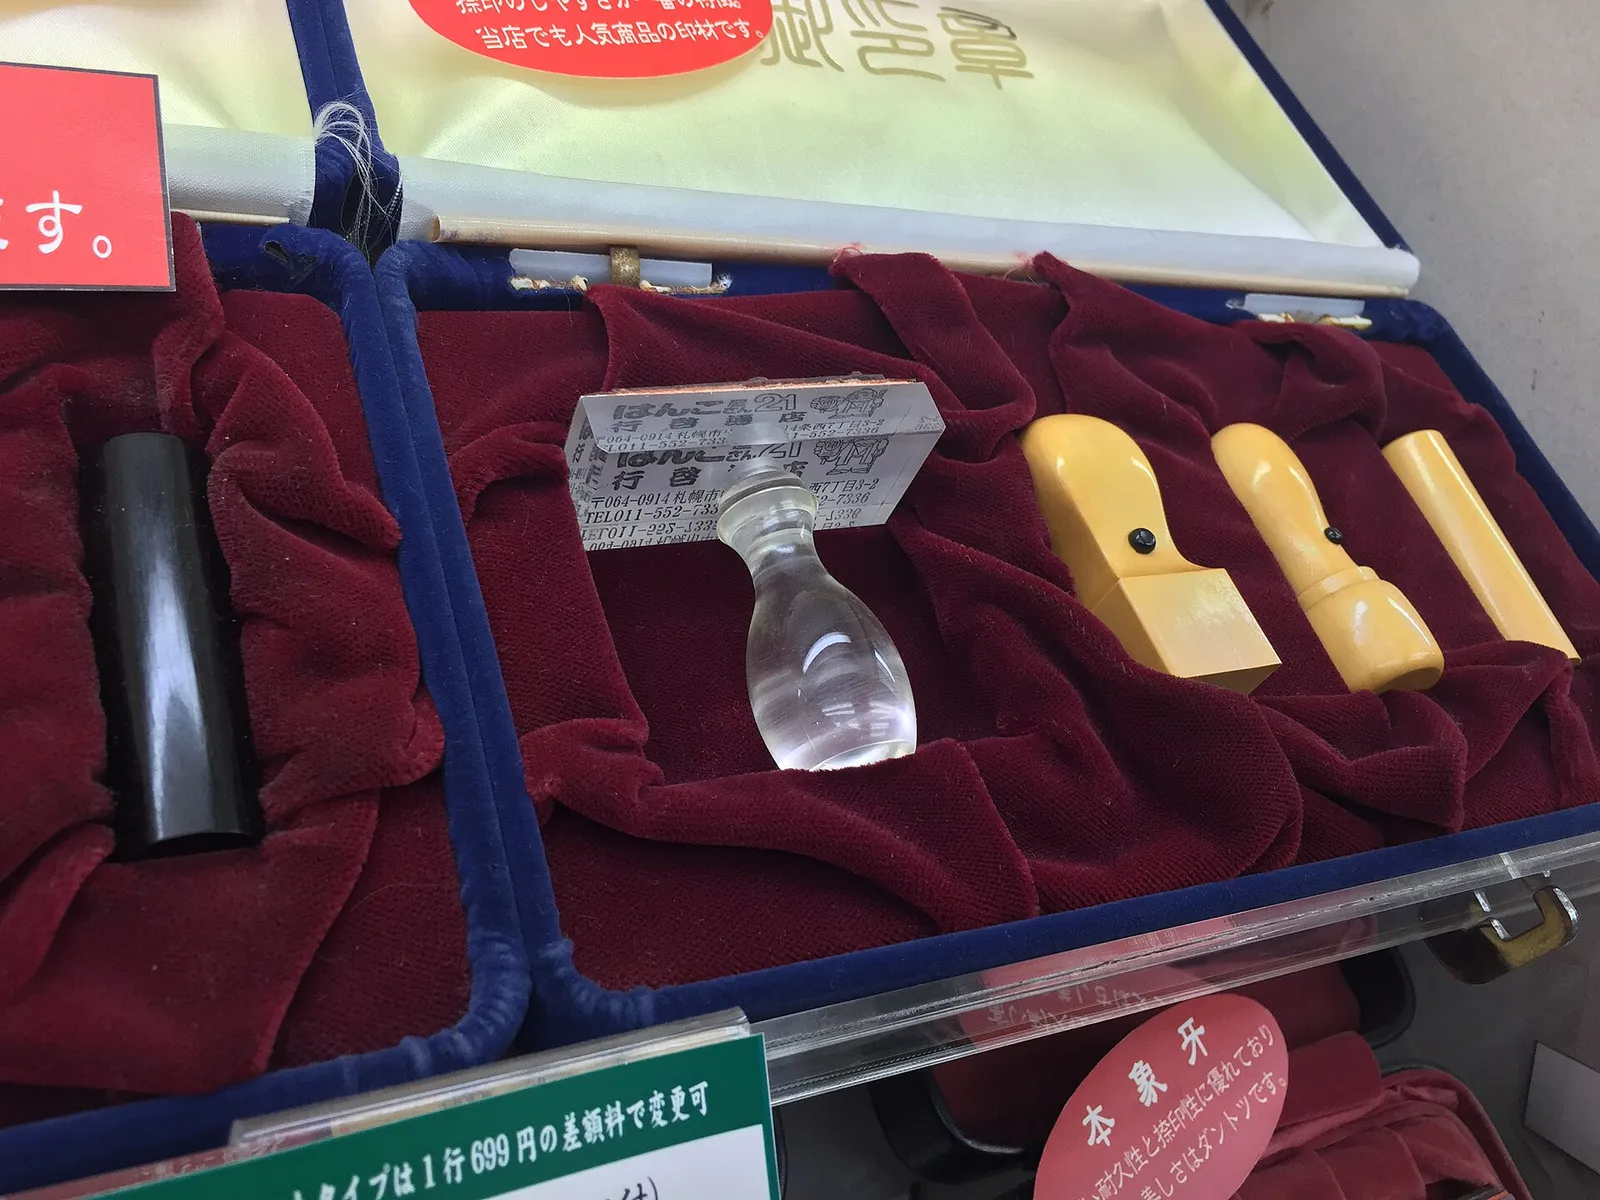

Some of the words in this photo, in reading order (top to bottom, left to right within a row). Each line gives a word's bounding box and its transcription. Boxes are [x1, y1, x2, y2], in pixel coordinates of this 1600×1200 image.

[456, 0, 742, 14] 捺印のしやすさ。
[475, 18, 763, 49] 当店でも人気商品の印材です。
[0, 189, 113, 259] す。
[585, 503, 719, 525] TEL011-552-733
[1079, 1024, 1274, 1200] 耐久性と捺印性に優れており
[1082, 1017, 1208, 1147] 本象牙
[293, 1080, 709, 1200] タイプは1行699円の差額料で変更可
